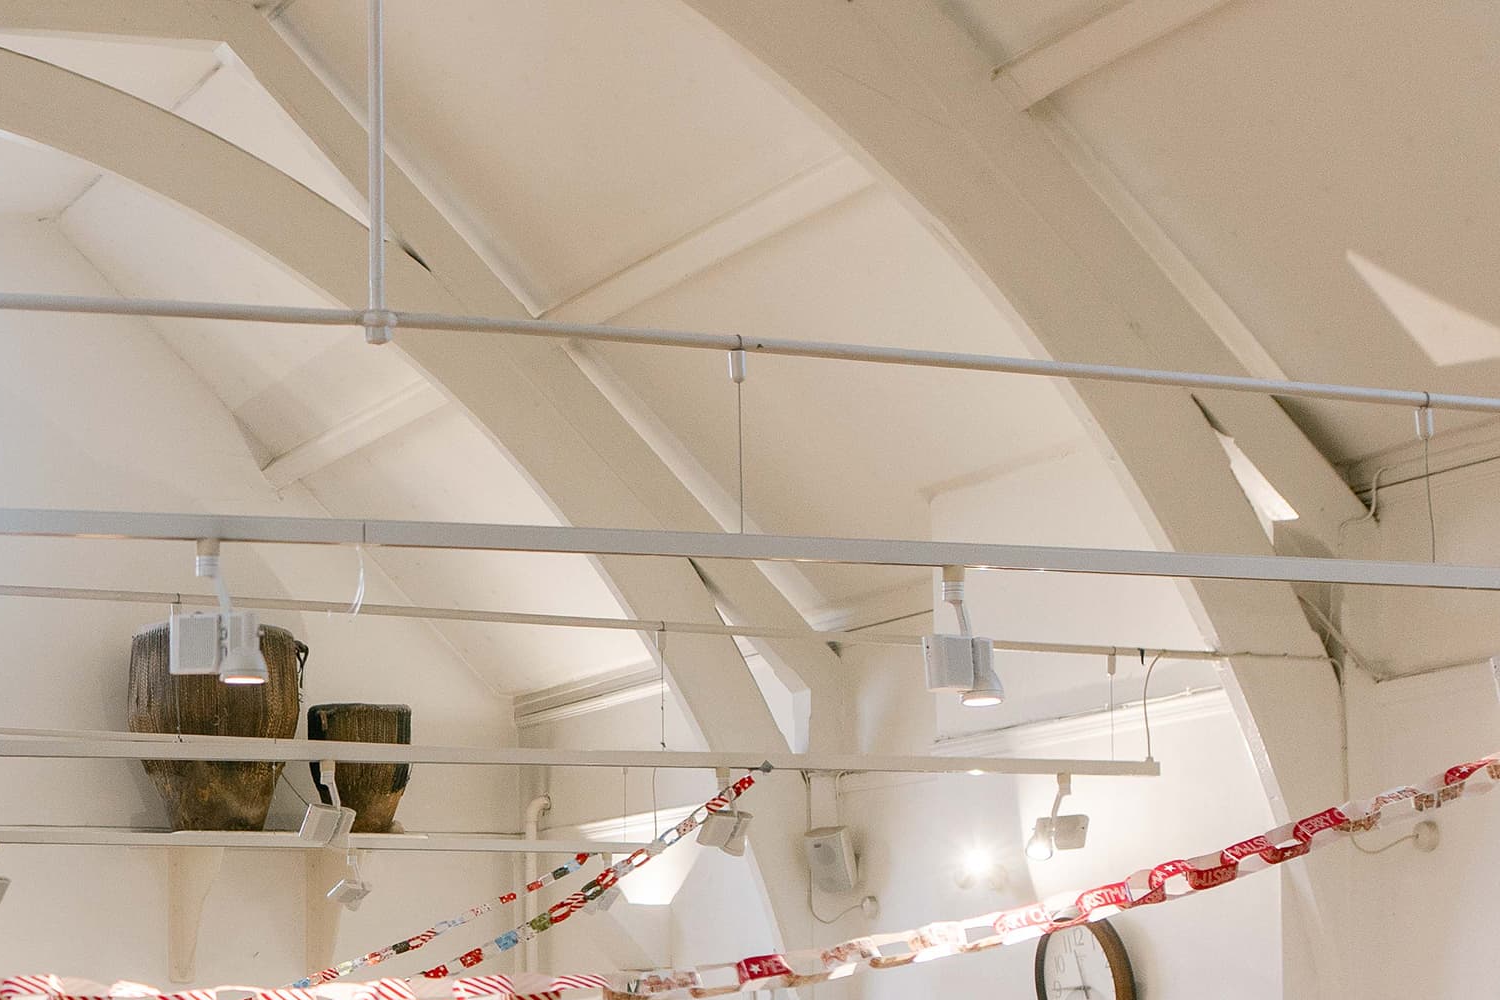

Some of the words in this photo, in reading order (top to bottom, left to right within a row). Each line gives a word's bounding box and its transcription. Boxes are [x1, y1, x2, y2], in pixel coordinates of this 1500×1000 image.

[1063, 935, 1073, 952] 11
[1074, 927, 1085, 946] 12
[1053, 954, 1065, 973] 10
[1052, 981, 1062, 998] 9
